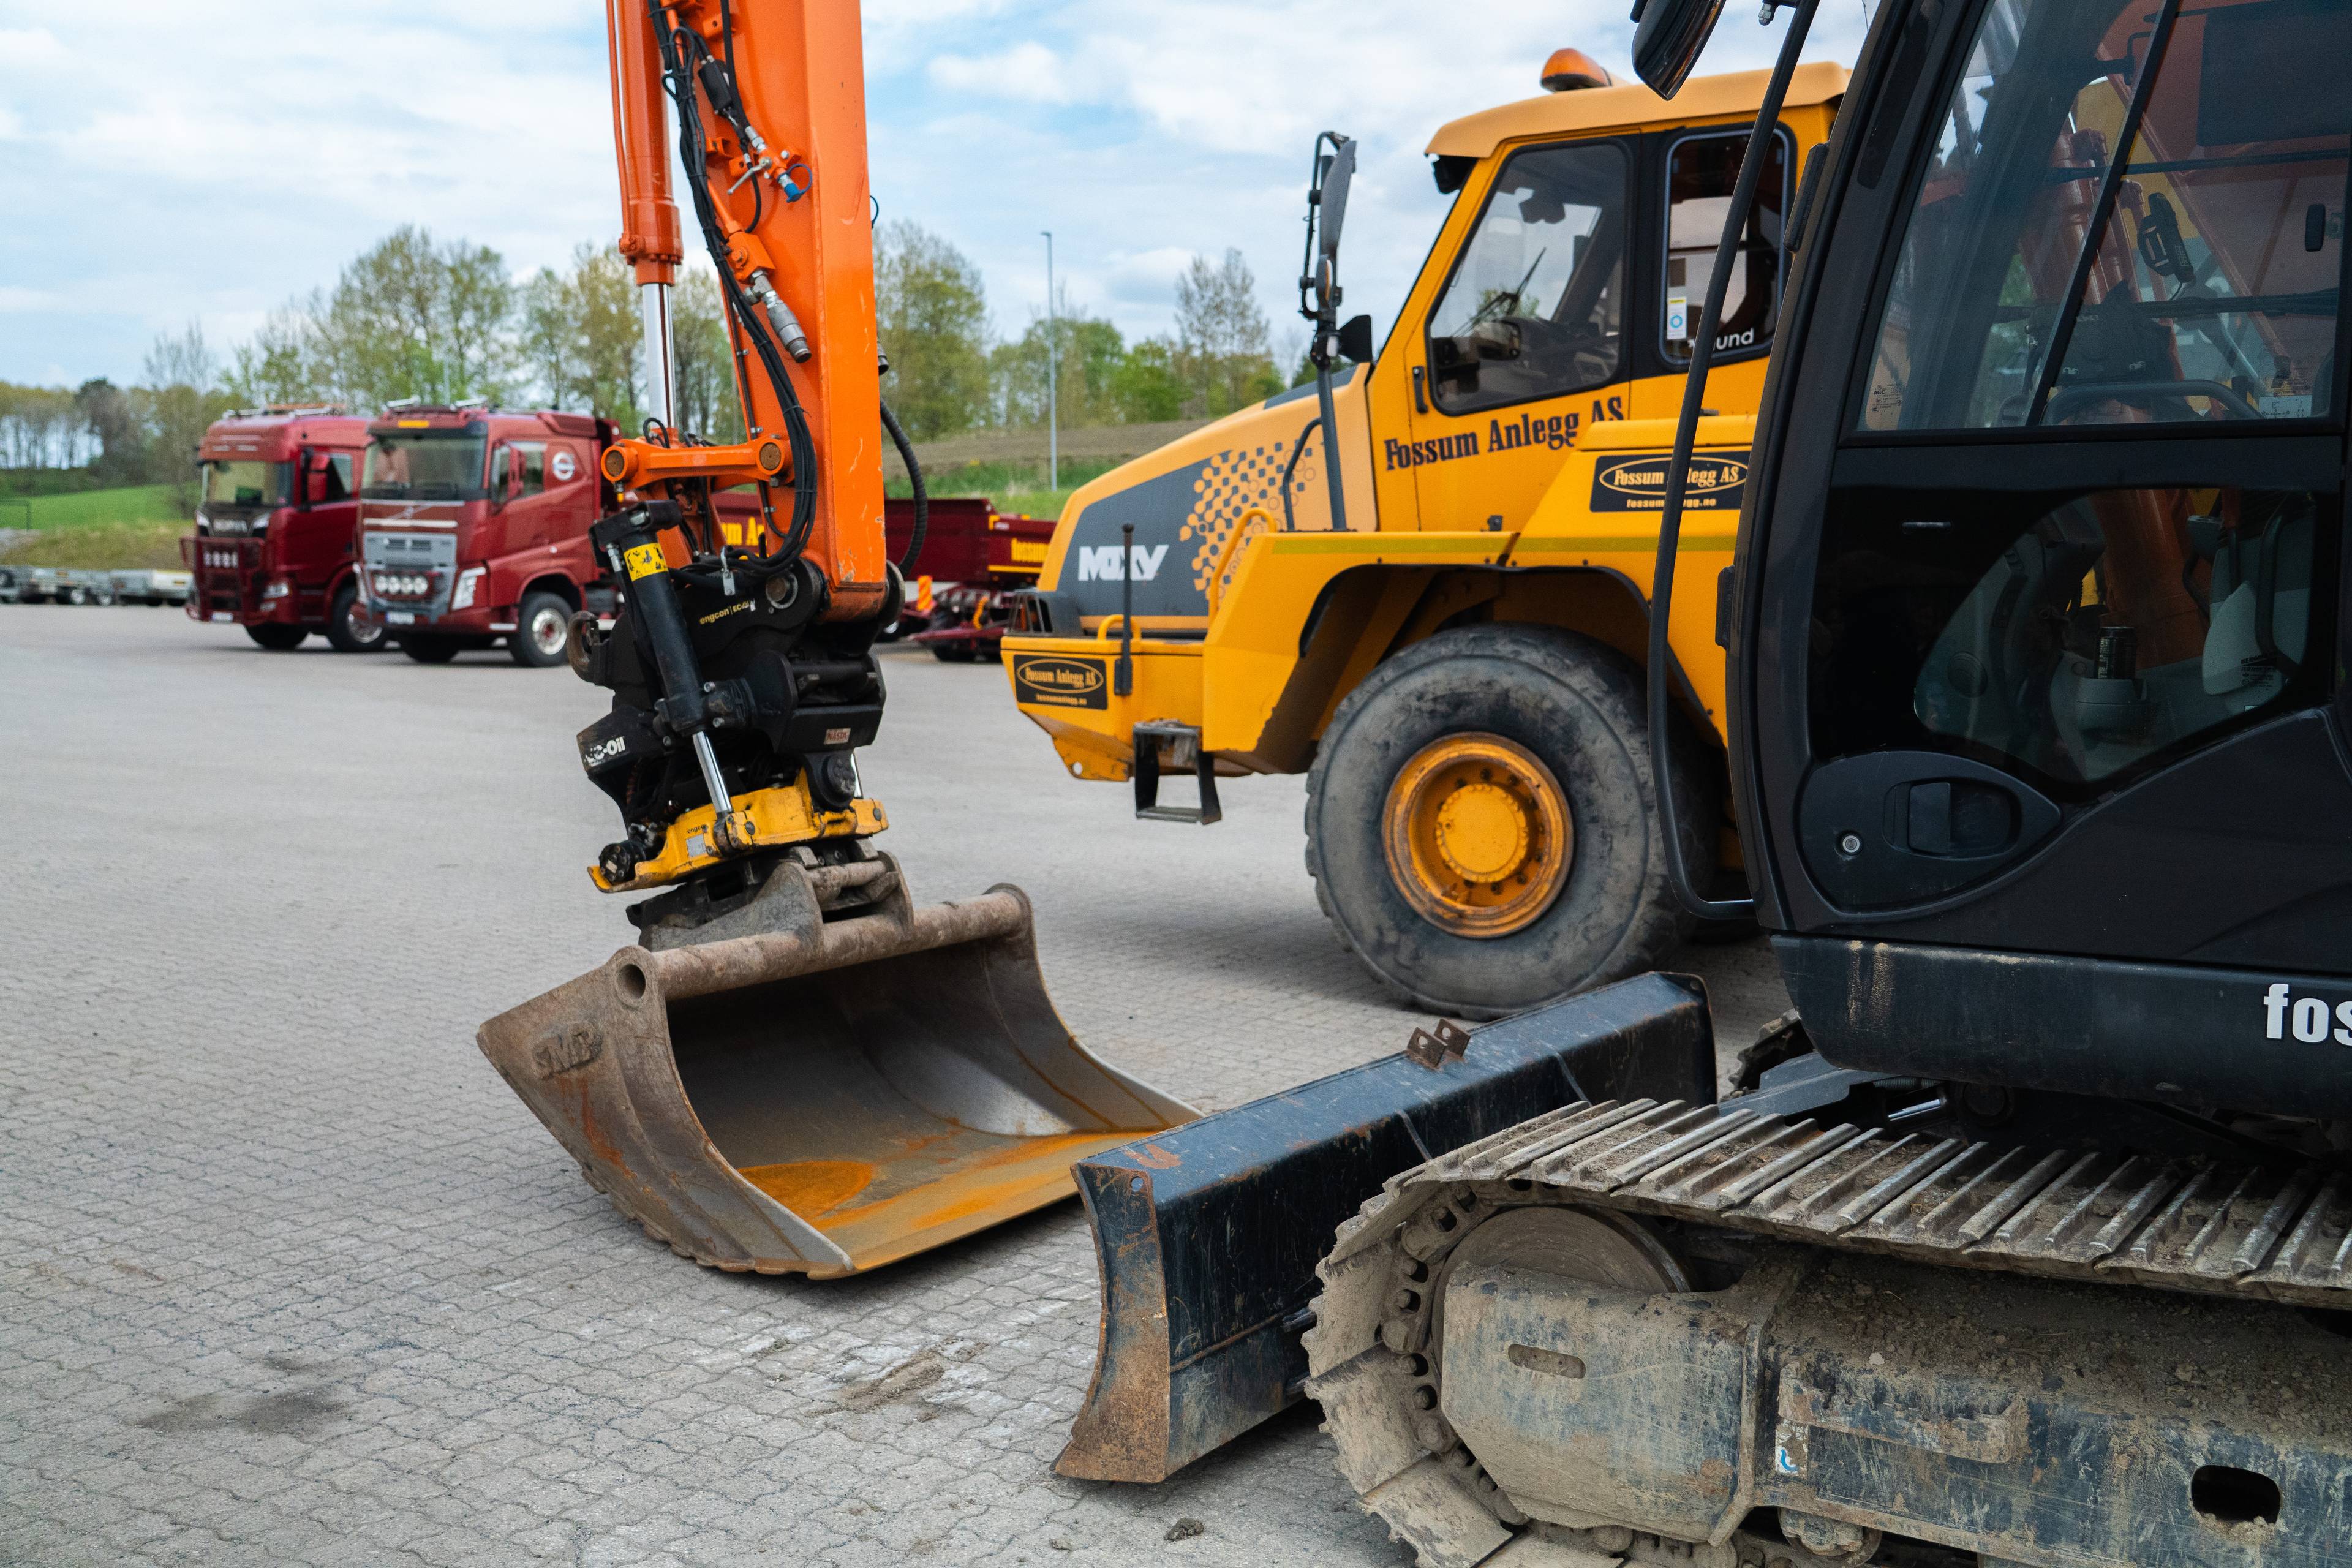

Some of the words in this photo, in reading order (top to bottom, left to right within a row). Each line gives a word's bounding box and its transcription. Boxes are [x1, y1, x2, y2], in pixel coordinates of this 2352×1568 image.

[1384, 431, 1479, 471] Fossum
[1488, 413, 1580, 450] Anlegg
[1592, 396, 1624, 421] AS
[1614, 469, 1665, 486] Fossum
[1686, 466, 1717, 488] legg
[1719, 466, 1740, 483] AS
[1078, 544, 1169, 581] MOXY
[699, 608, 729, 624] engcon
